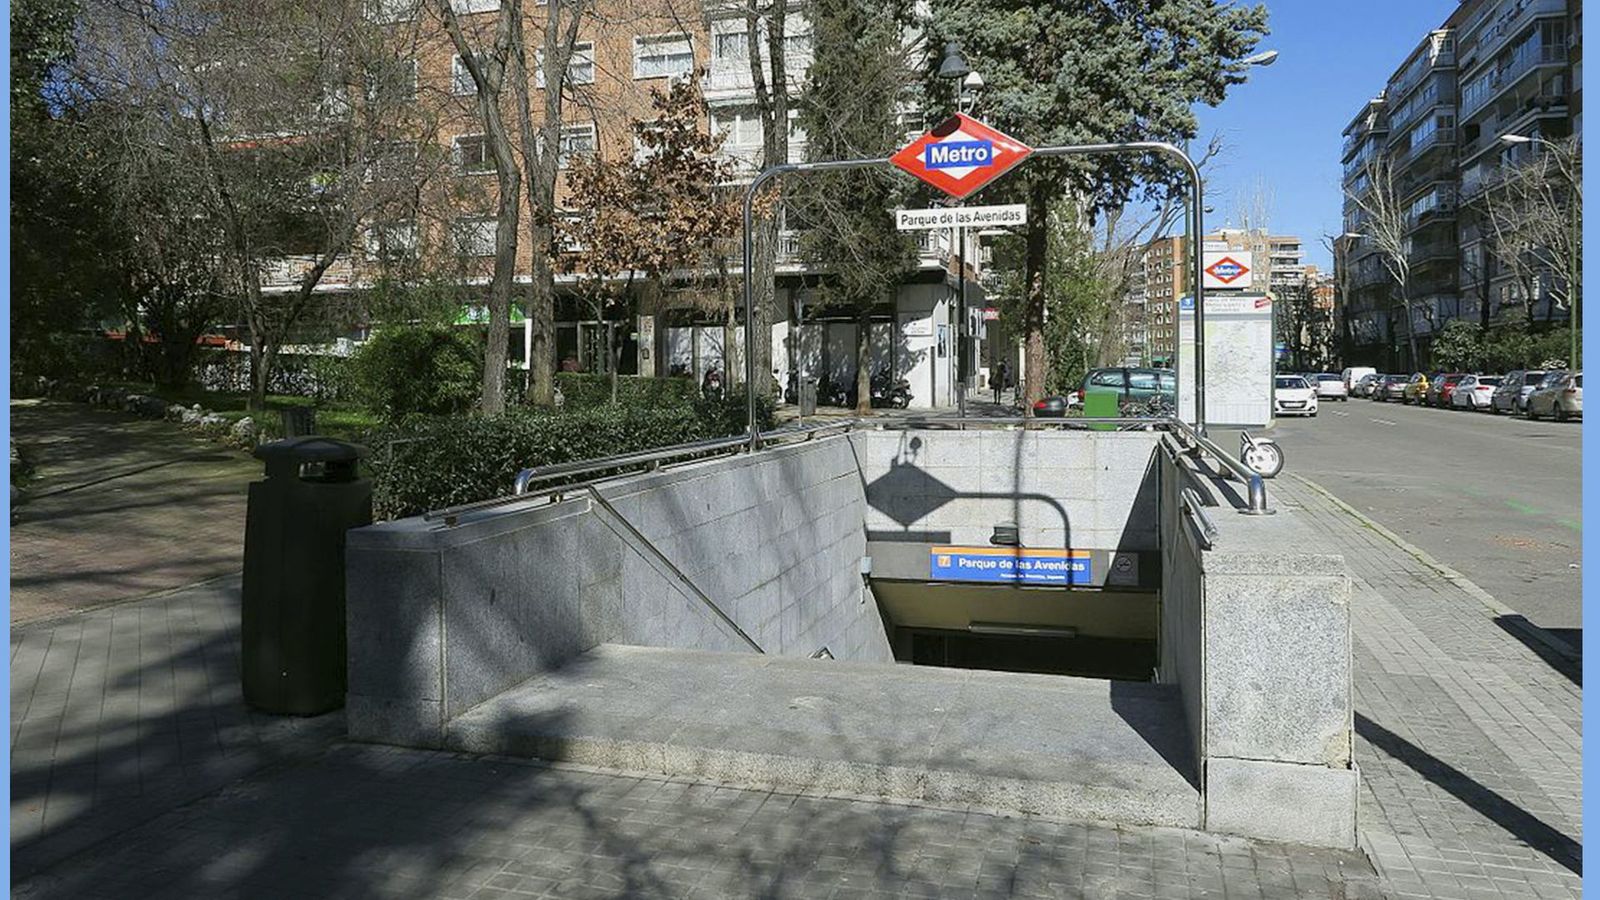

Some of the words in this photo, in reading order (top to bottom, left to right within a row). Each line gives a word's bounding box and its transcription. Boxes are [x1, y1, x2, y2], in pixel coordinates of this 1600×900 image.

[930, 146, 988, 164] Metro
[901, 213, 937, 226] Parque
[940, 213, 953, 224] de
[956, 212, 972, 223] las
[973, 209, 1021, 223] Avenidas
[958, 557, 996, 571] Parque
[999, 558, 1013, 570] de
[1015, 559, 1031, 570] las
[1034, 559, 1085, 571] Avenidas
